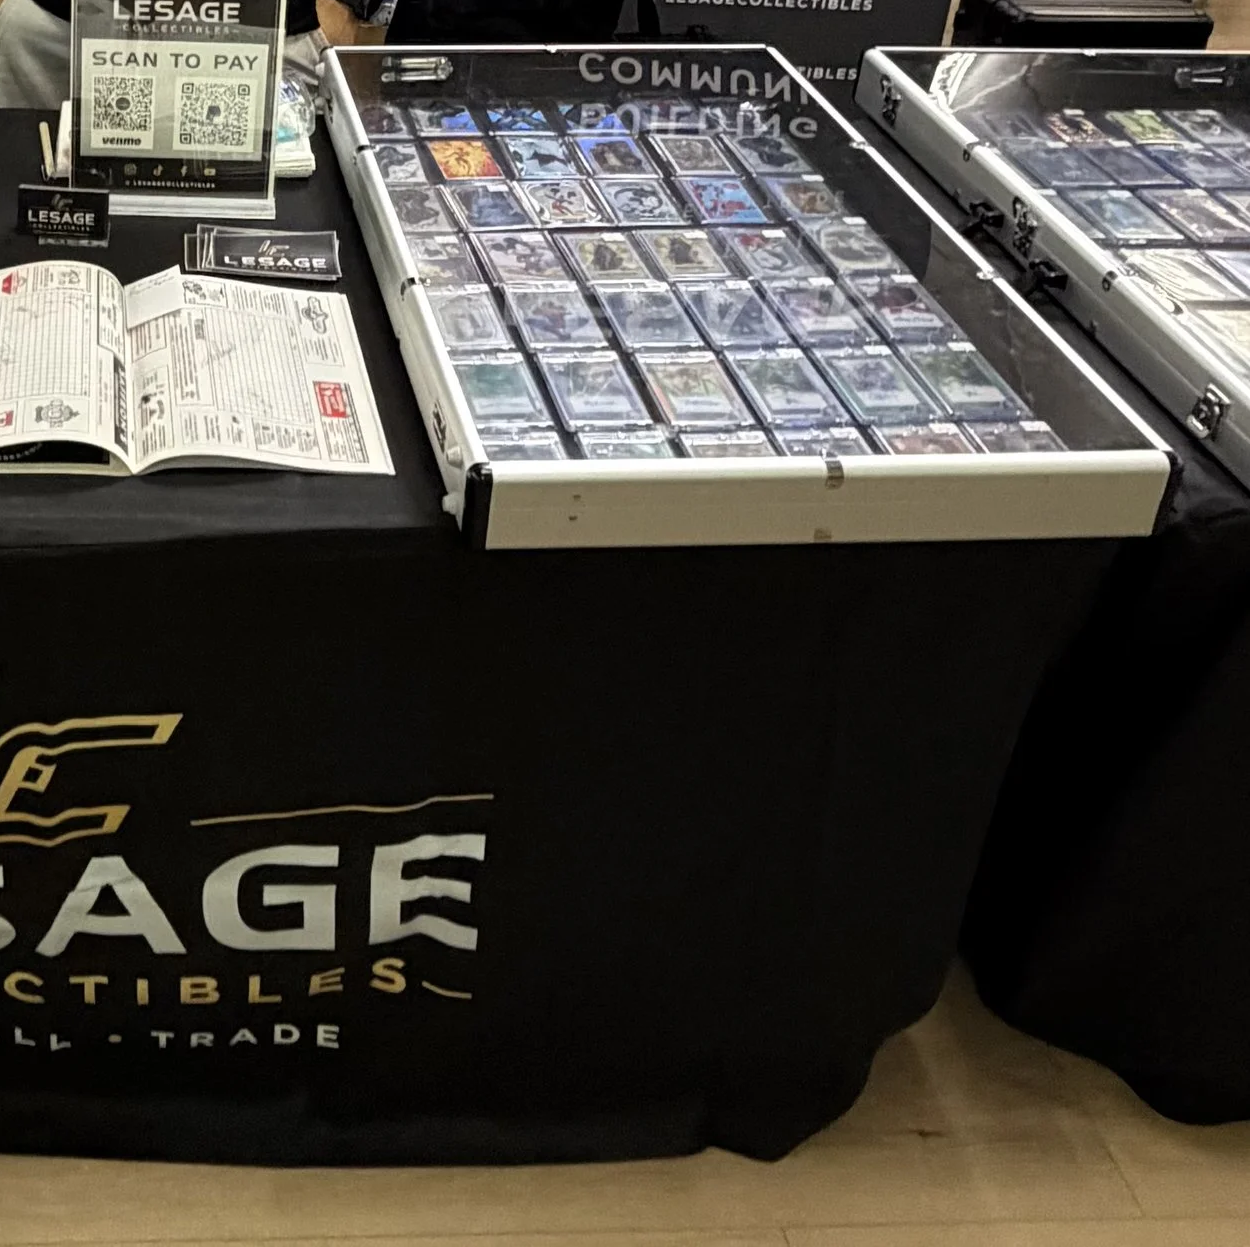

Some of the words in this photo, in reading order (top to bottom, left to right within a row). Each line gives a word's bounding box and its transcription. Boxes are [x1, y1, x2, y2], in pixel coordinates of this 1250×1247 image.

[113, 0, 240, 24] LESAGE
[93, 51, 157, 67] SCAN
[170, 53, 200, 68] TO
[214, 55, 258, 70] PAY
[102, 137, 141, 145] venmo
[28, 209, 95, 226] LESAGE
[223, 256, 327, 269] LESAGE
[151, 1024, 339, 1048] TRADE
